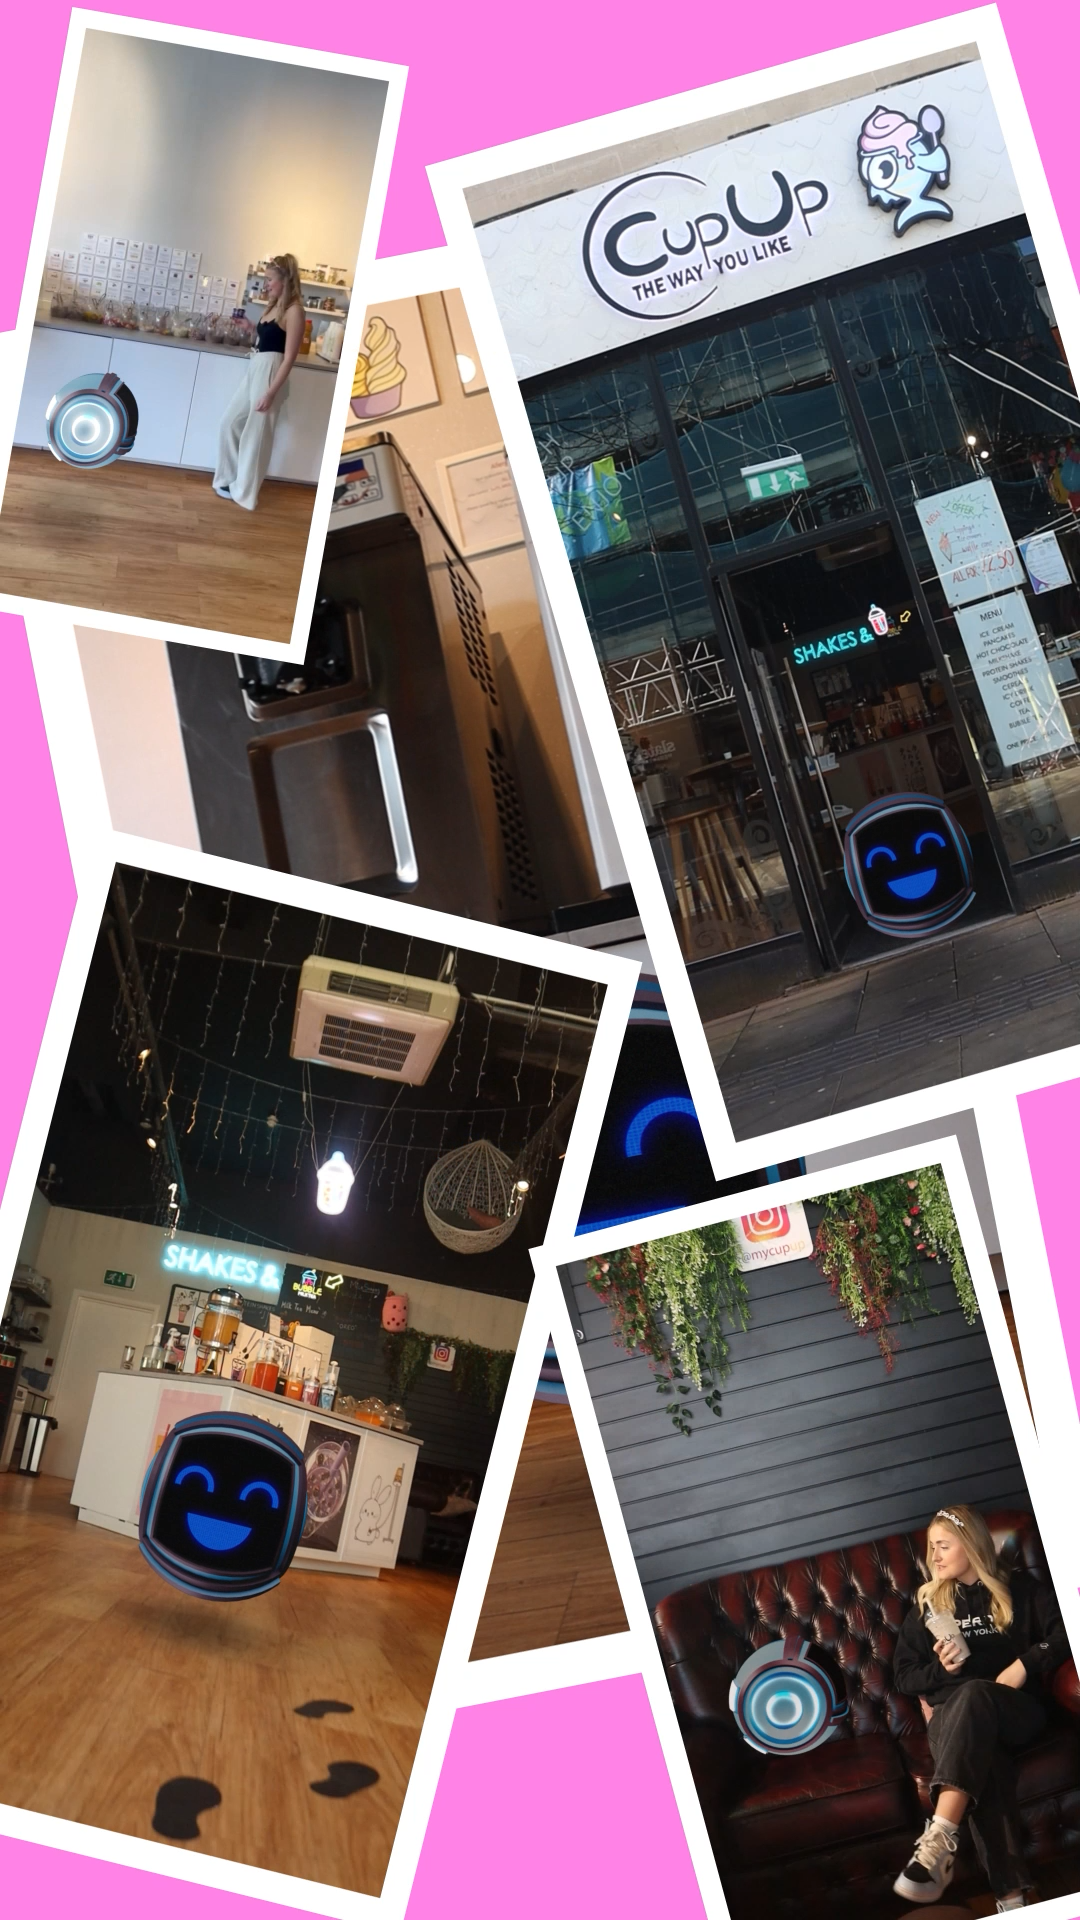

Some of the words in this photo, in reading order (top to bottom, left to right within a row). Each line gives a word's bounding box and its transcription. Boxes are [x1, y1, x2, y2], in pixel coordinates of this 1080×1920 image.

[604, 171, 829, 277] CupUp
[632, 279, 667, 302] THE
[667, 264, 705, 291] WAY
[714, 251, 750, 276] YOU
[753, 236, 793, 262] LIKE
[572, 462, 632, 532] ENJOY
[952, 502, 975, 515] OFFER
[925, 511, 942, 526] NEW
[952, 569, 967, 584] ALL
[966, 566, 981, 578] FOR
[979, 608, 1003, 622] MENU
[980, 630, 990, 638] ICE
[992, 622, 1015, 634] CREAM
[983, 632, 1016, 647] PANCAKES
[793, 631, 858, 664] SHAKES
[859, 627, 875, 643] &
[976, 649, 989, 659] HOT
[990, 638, 1029, 655] CHOCOLATE
[982, 664, 1008, 677] PROTEIN
[1009, 656, 1032, 669] SHAKES
[1006, 742, 1019, 750] ONE
[742, 1240, 806, 1263] @mycupup
[163, 1244, 259, 1283] SHAKES
[260, 1264, 280, 1290] &
[292, 1282, 323, 1296] BUBBLE
